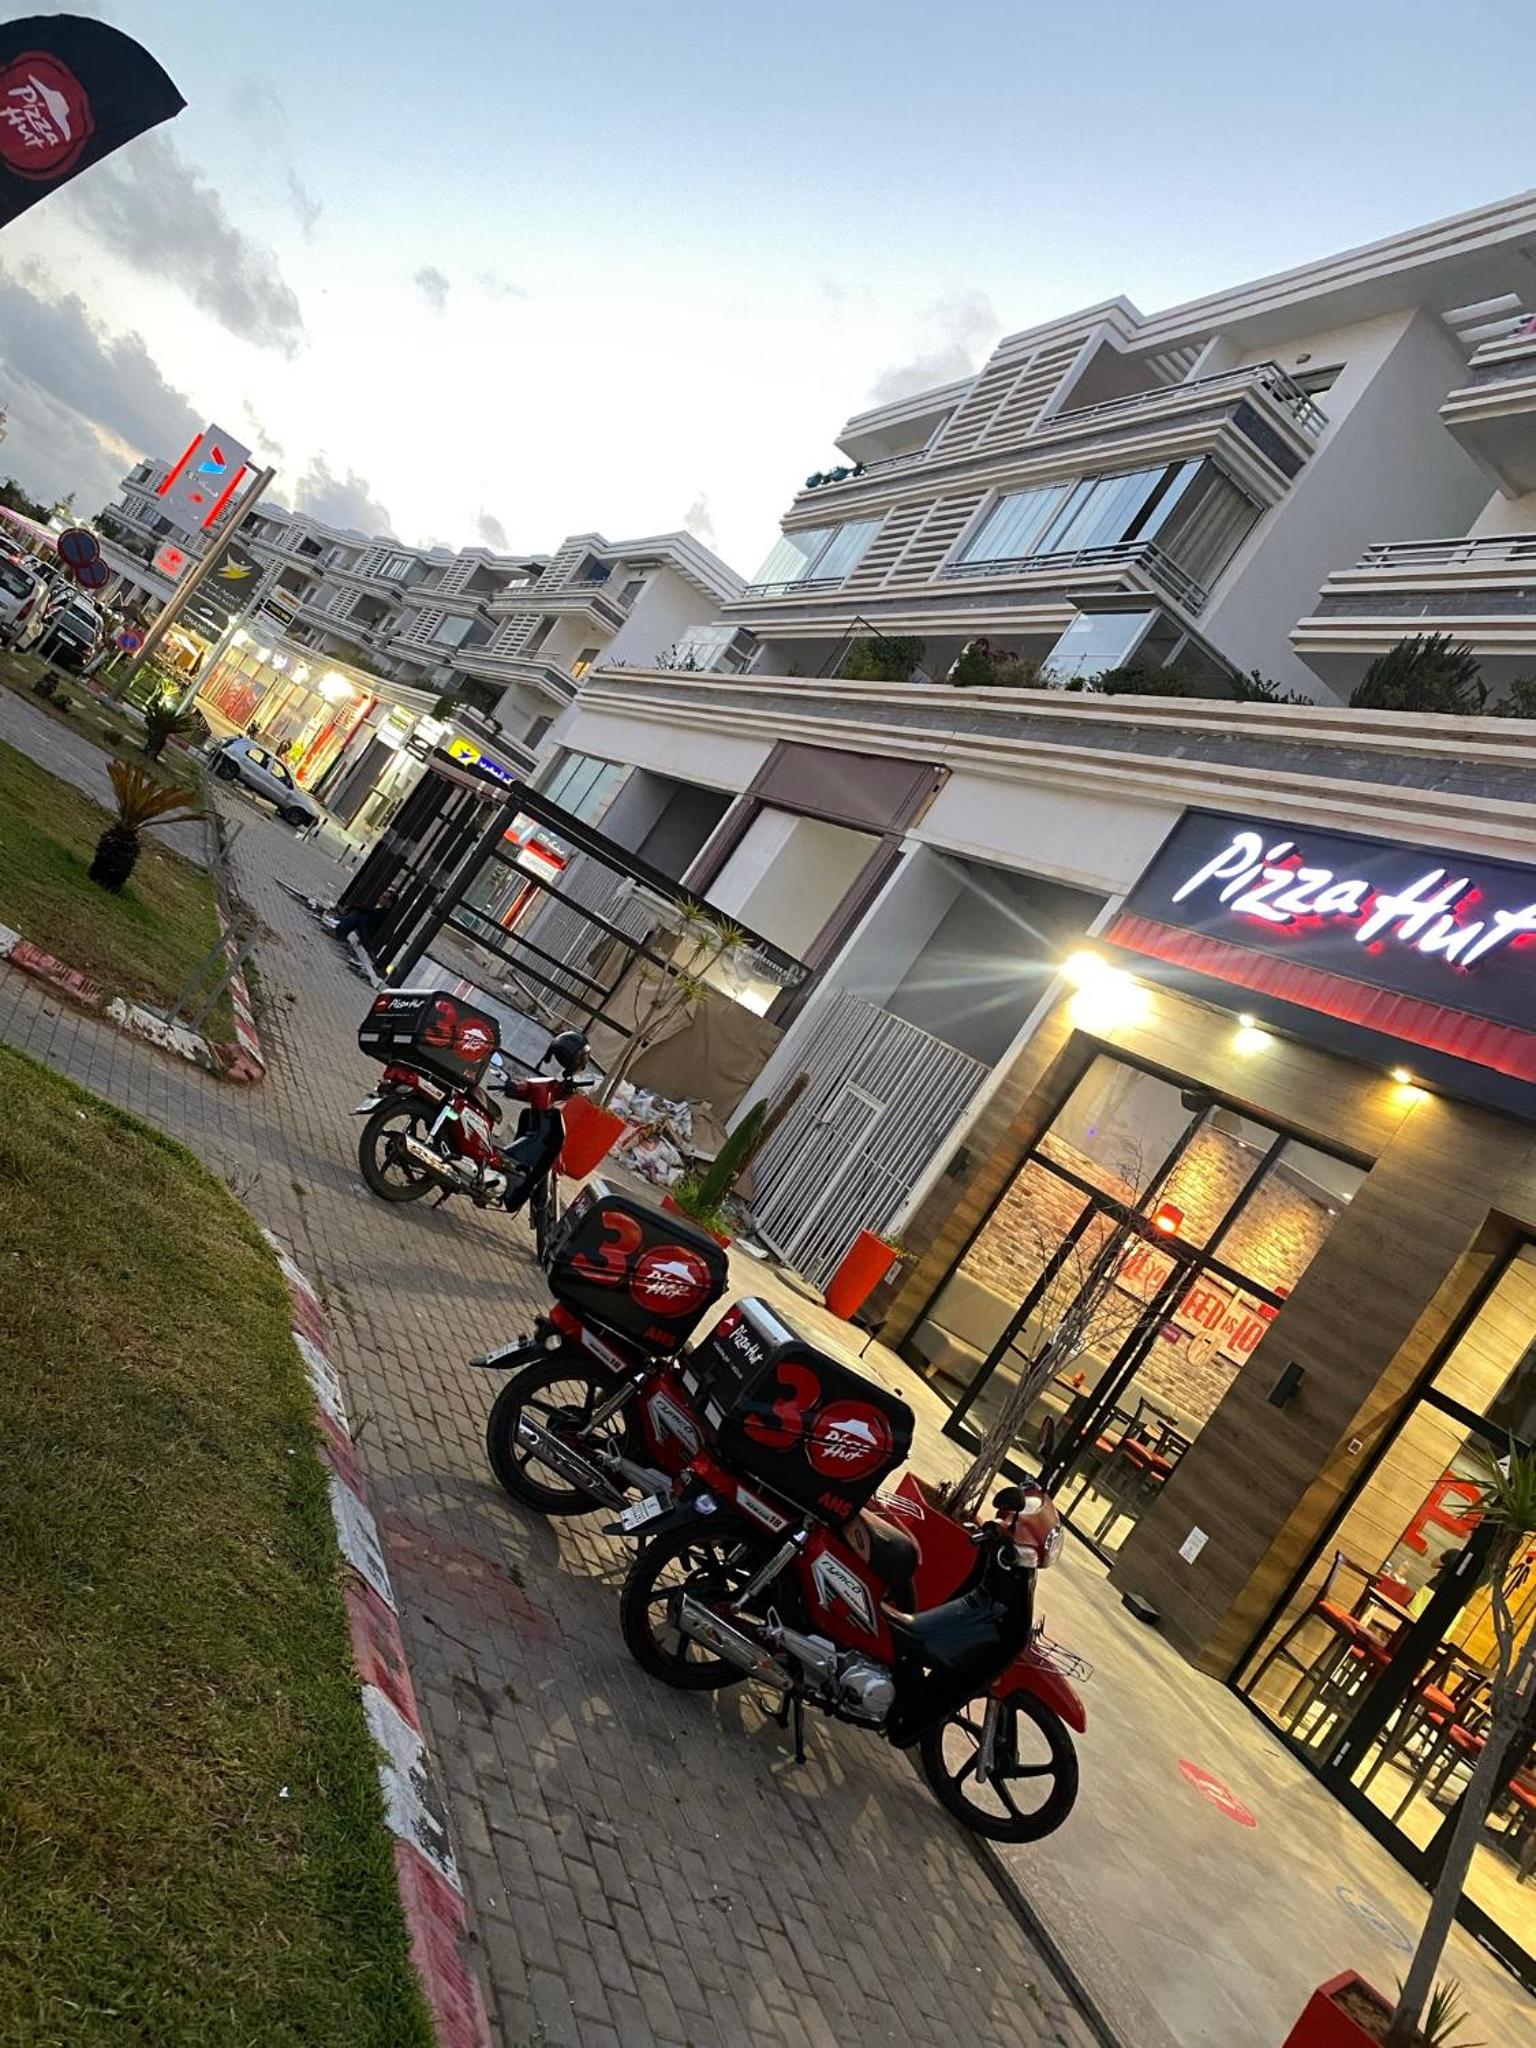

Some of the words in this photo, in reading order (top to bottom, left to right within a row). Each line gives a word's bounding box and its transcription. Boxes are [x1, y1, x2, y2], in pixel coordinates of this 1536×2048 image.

[8, 85, 60, 147] Pizza
[1171, 831, 1371, 923] Pizza
[1355, 867, 1536, 967] Hut
[1179, 1285, 1227, 1331] EED
[1221, 1314, 1240, 1334] IS
[728, 1324, 751, 1350] Pizza
[743, 1341, 763, 1365] Hut
[1226, 1314, 1265, 1354] LO
